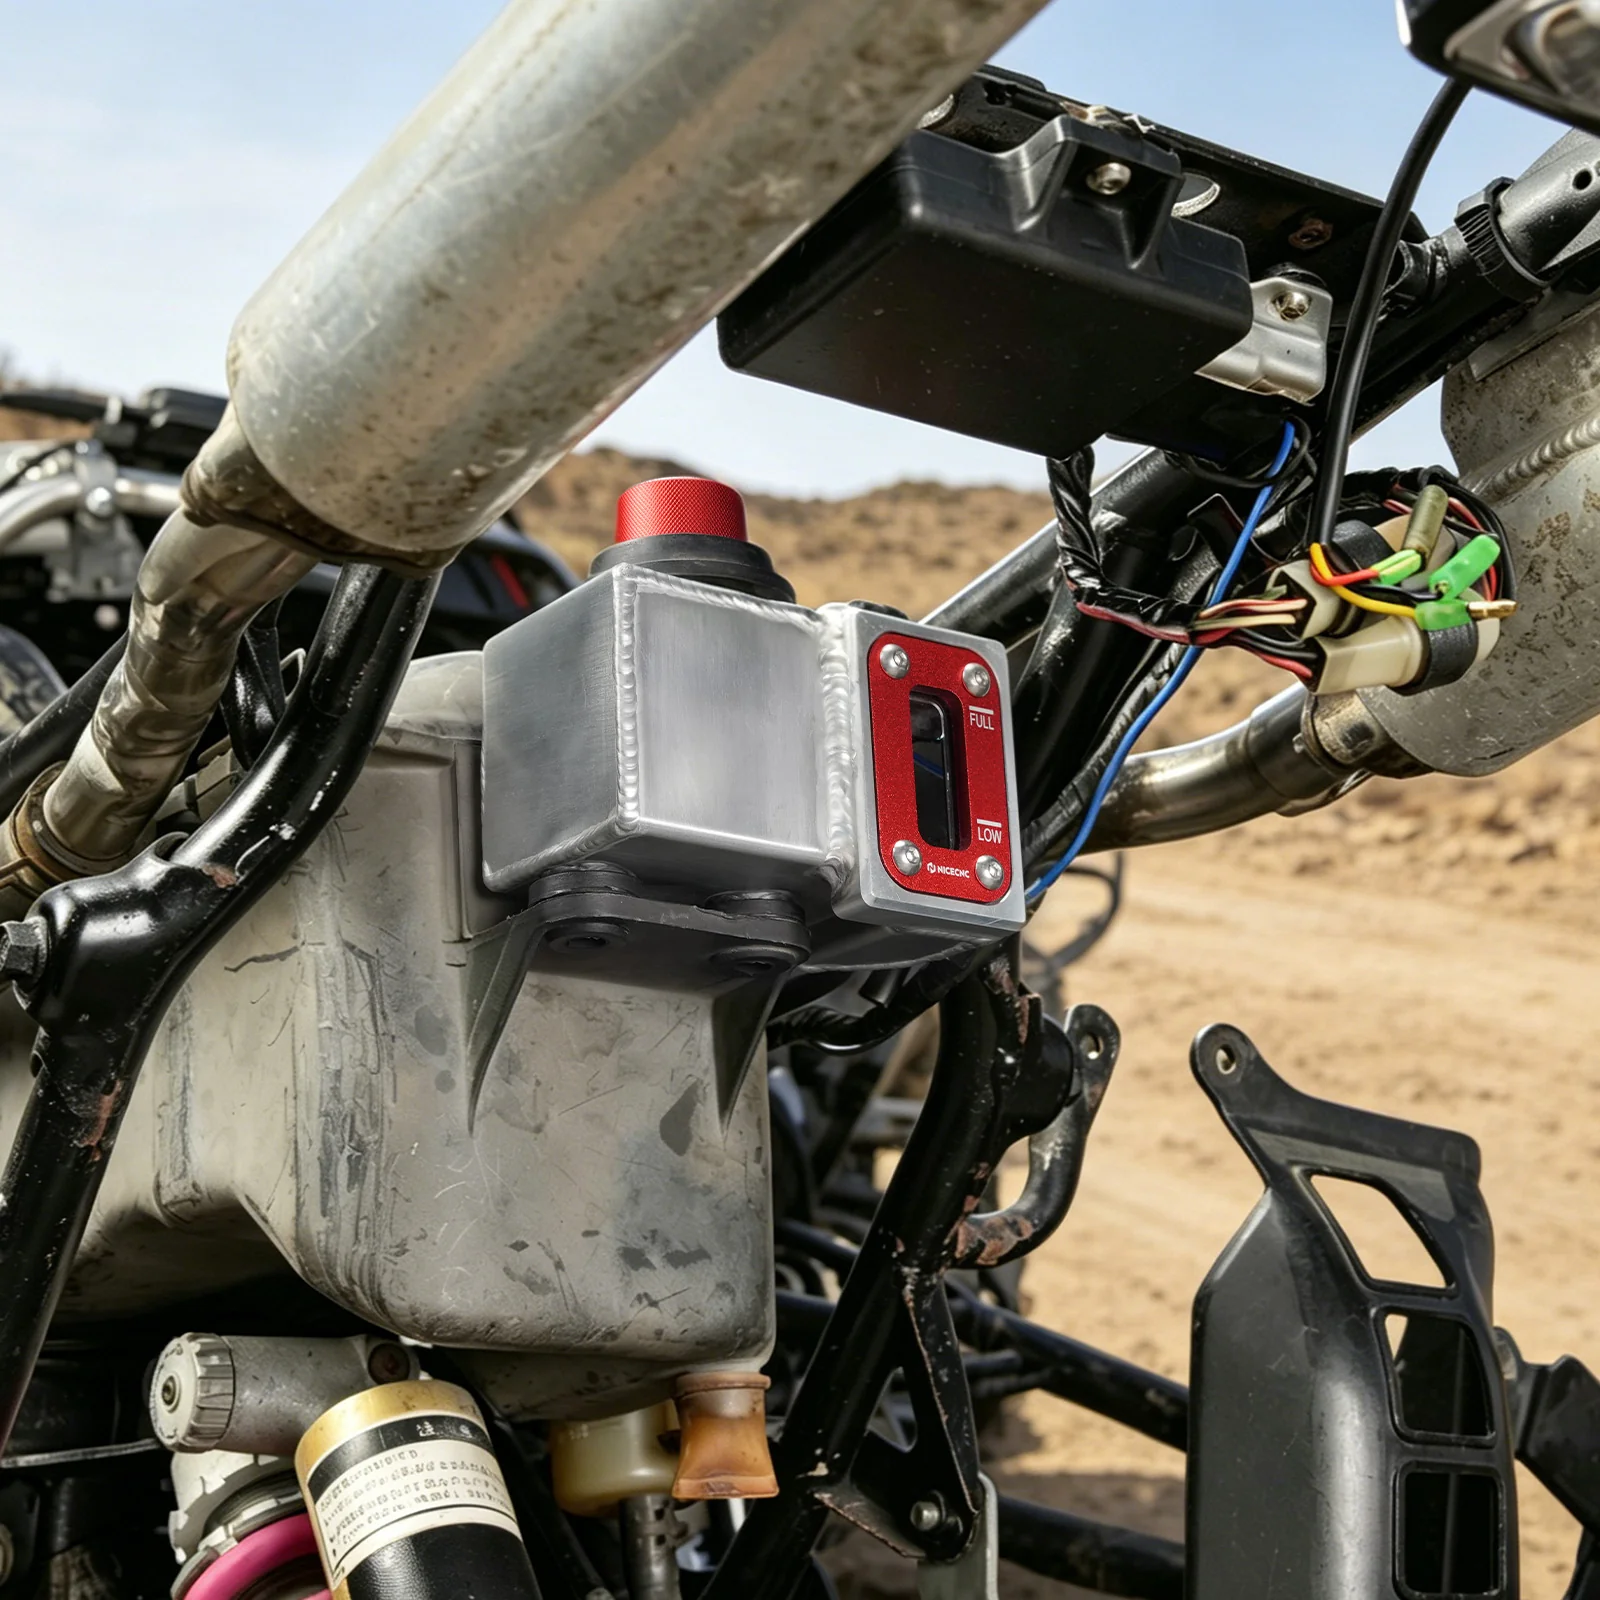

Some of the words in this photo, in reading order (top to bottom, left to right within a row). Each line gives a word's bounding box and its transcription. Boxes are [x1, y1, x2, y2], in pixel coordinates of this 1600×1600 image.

[969, 712, 995, 731] FULL
[977, 826, 1002, 844] LOW
[937, 865, 970, 879] NICECNC
